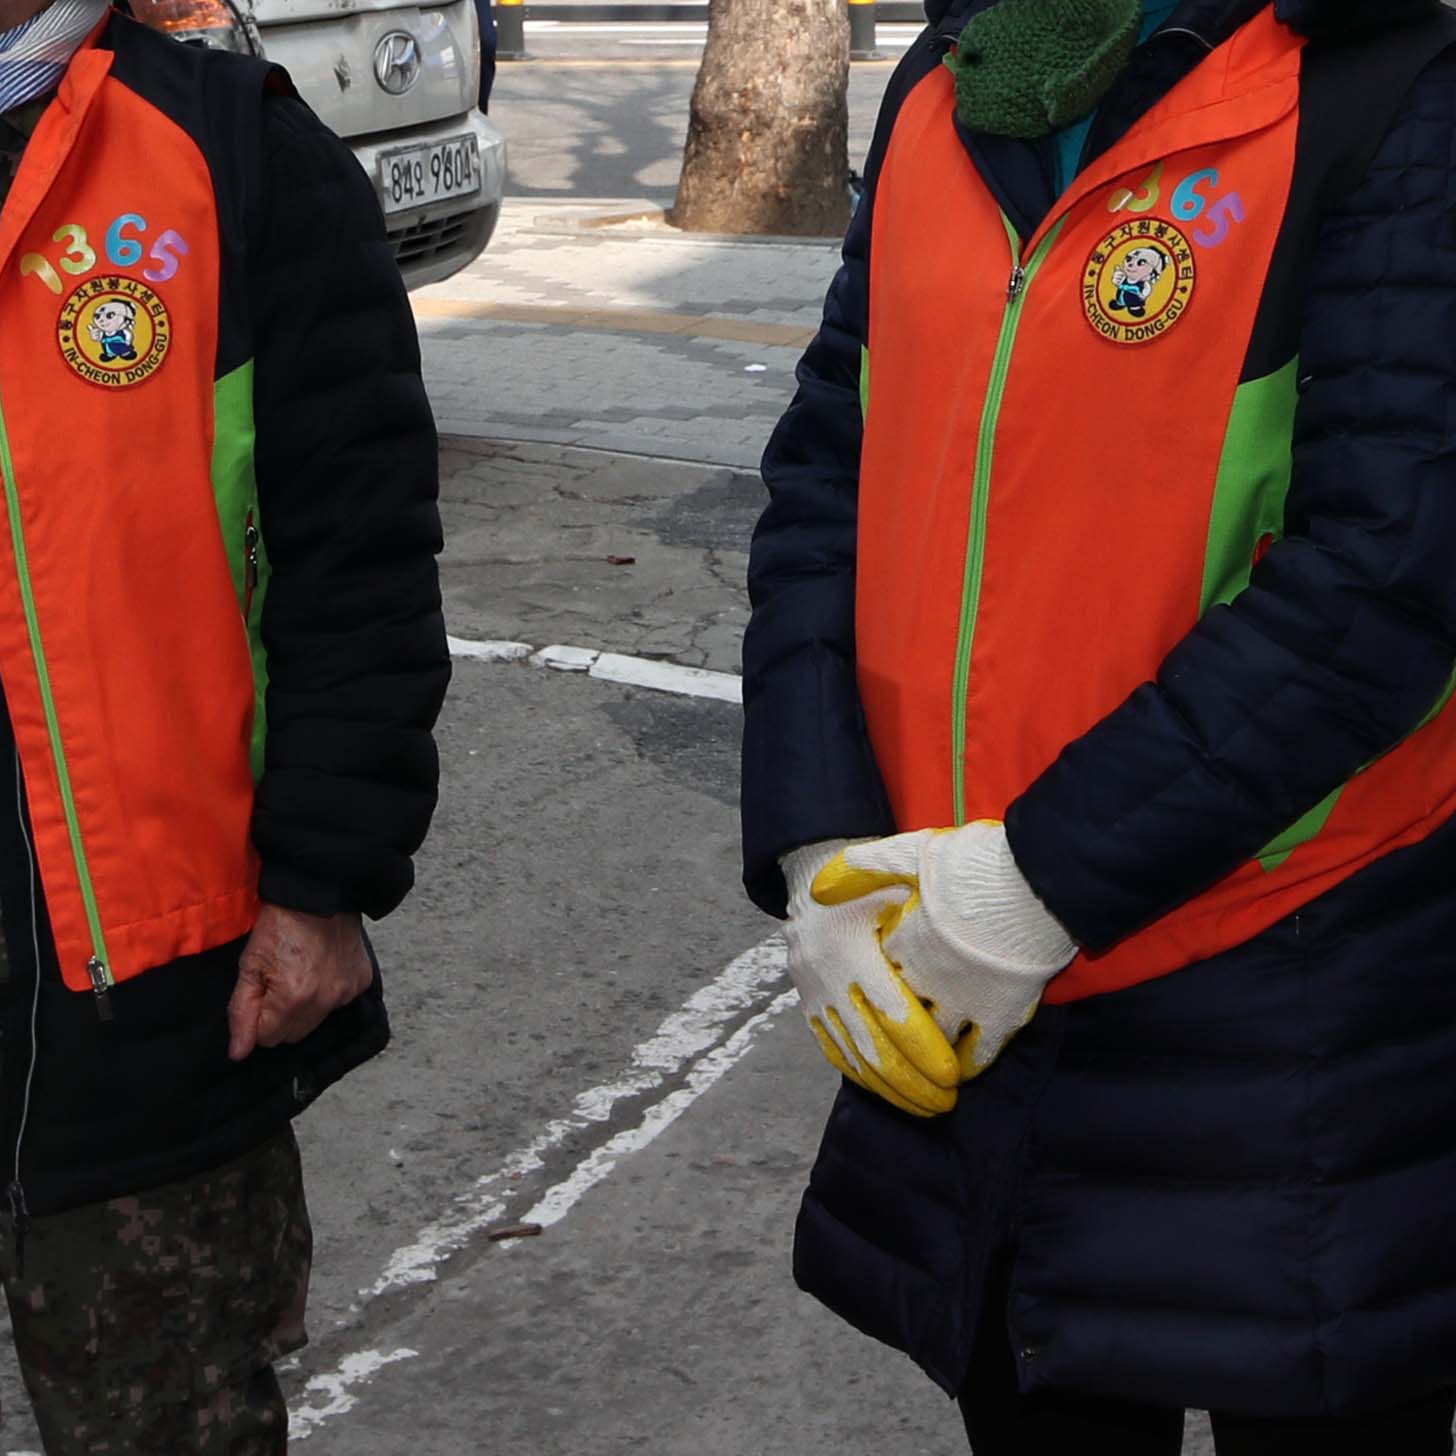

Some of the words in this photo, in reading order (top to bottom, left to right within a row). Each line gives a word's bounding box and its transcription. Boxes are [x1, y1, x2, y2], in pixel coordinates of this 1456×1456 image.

[20, 212, 190, 295] 1365
[1084, 284, 1121, 340] IN-CHEON
[1124, 300, 1184, 342] DONG-GU
[63, 346, 122, 385] IN-CHEON
[125, 333, 168, 383] DONG-GU
